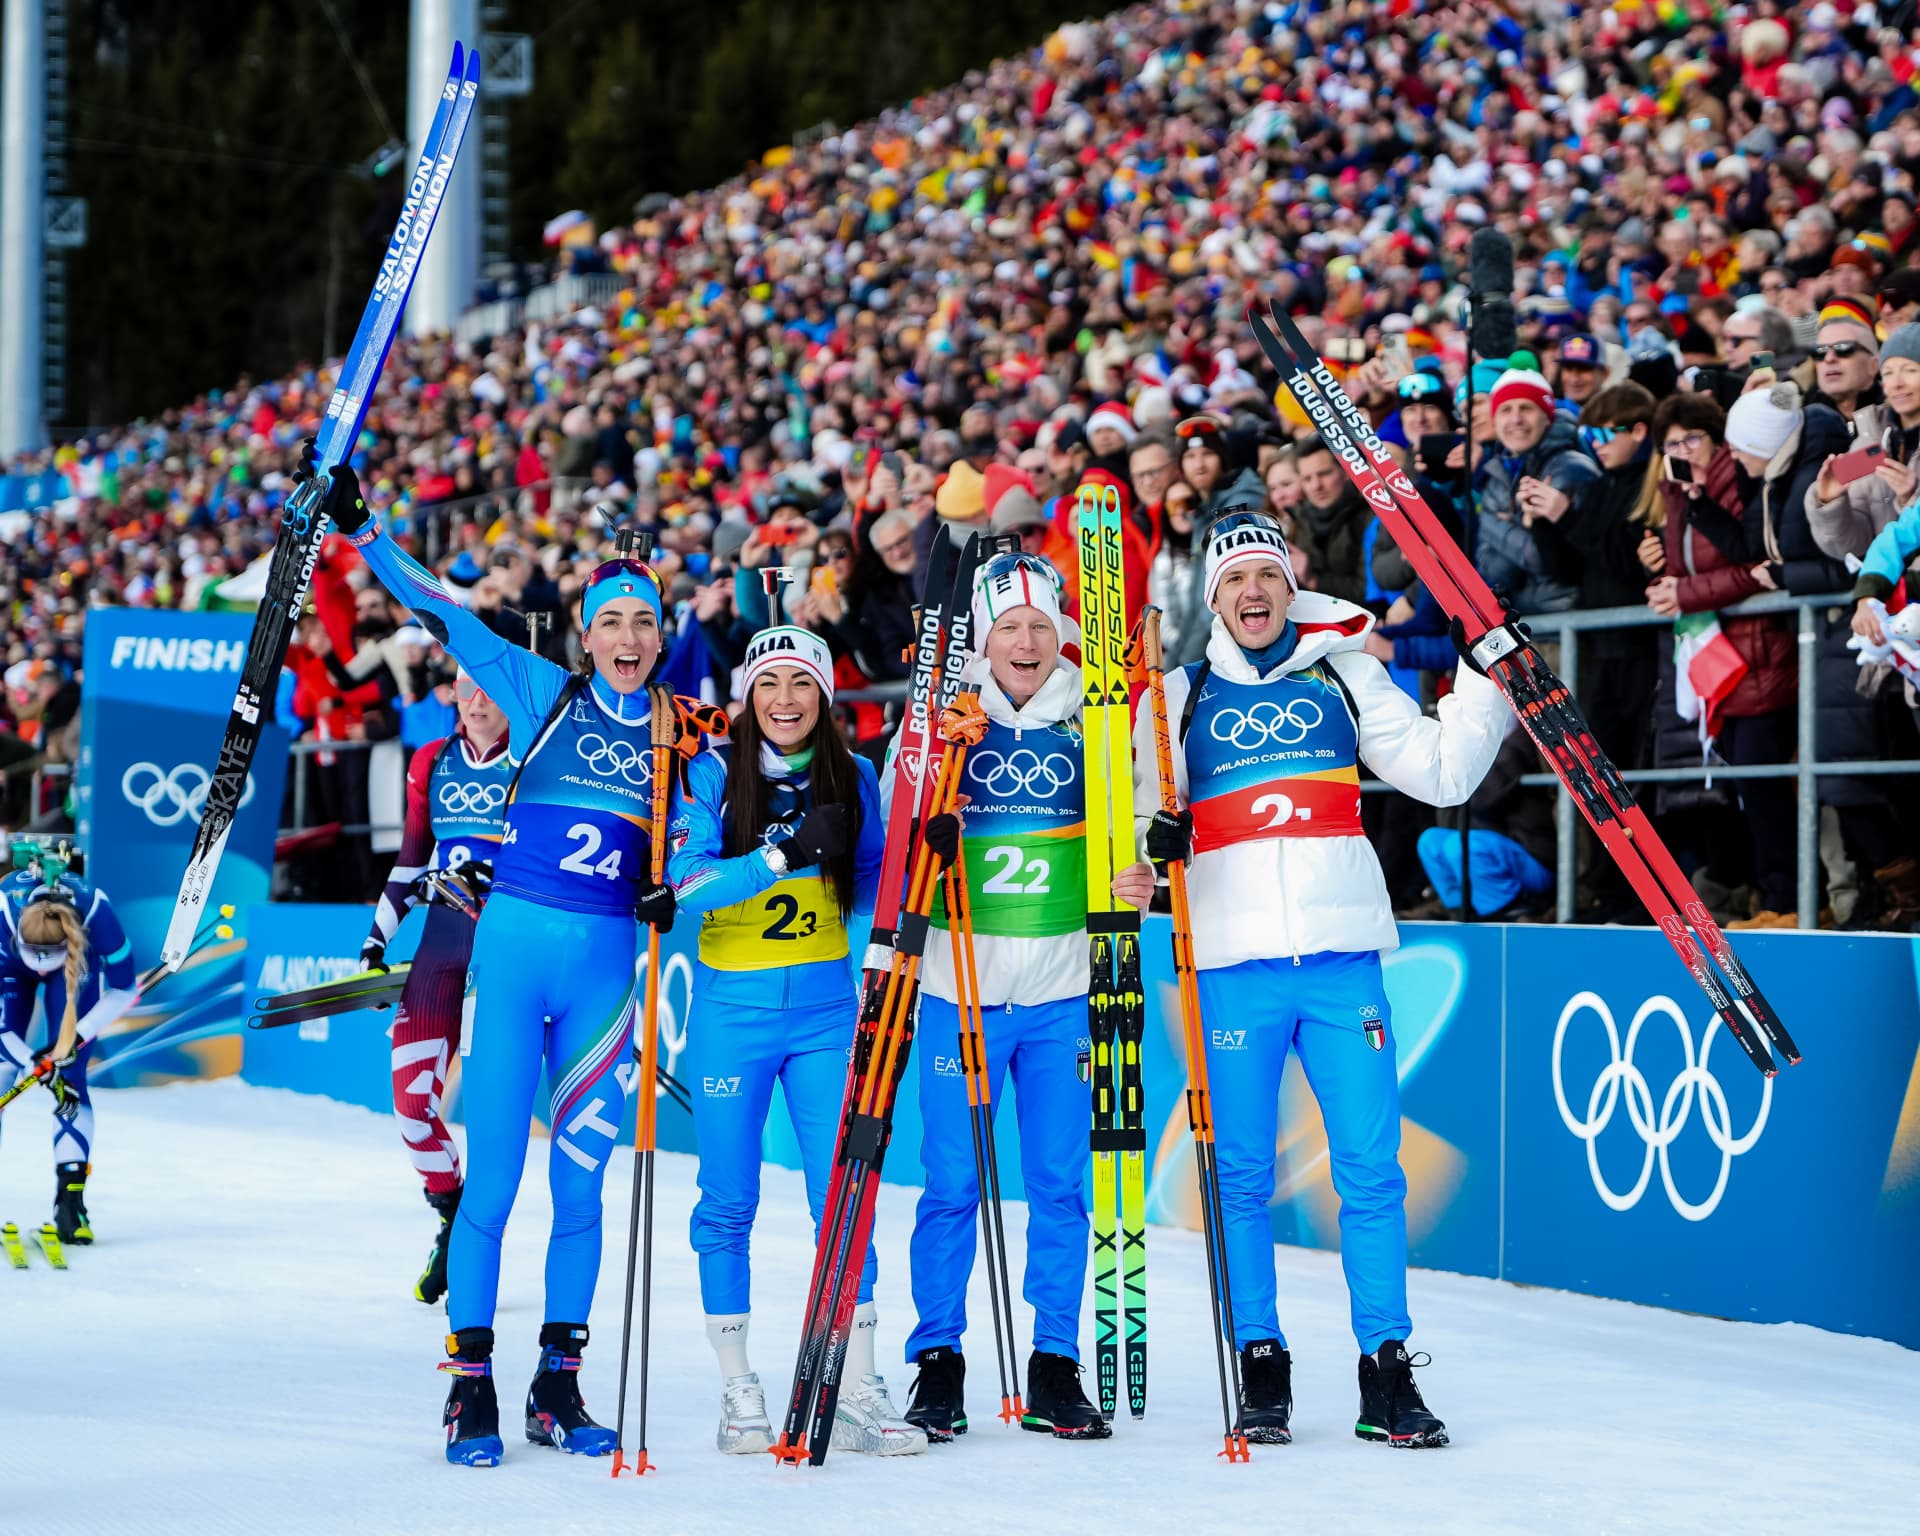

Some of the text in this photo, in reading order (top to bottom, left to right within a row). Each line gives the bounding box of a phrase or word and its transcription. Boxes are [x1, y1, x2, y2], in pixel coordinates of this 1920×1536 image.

[375, 155, 434, 296] SALOMON
[394, 153, 455, 295] SALOMON
[1288, 367, 1369, 476] ROSSIGNOL
[1310, 357, 1392, 465] ROSSIGNOL
[288, 512, 331, 621] SALOMON
[1216, 530, 1287, 557] ITALIA
[1083, 527, 1099, 669] FISCHER
[1106, 525, 1122, 668] FISCHER
[111, 636, 245, 673] FINISH
[744, 635, 796, 672] ALIA
[909, 603, 942, 735] ROSSIGNOL
[1212, 749, 1336, 776] MILANO CORTINA 2026
[560, 774, 603, 789] MILANO
[604, 783, 645, 803] CORTINA
[961, 804, 1008, 814] MILANO
[1009, 805, 1057, 816] CORTINA
[559, 822, 623, 881] 24
[982, 845, 1050, 894] 22
[761, 893, 817, 941] 23
[1212, 1030, 1247, 1046] EA7
[703, 1076, 742, 1093] EA7
[721, 1324, 744, 1334] EA7
